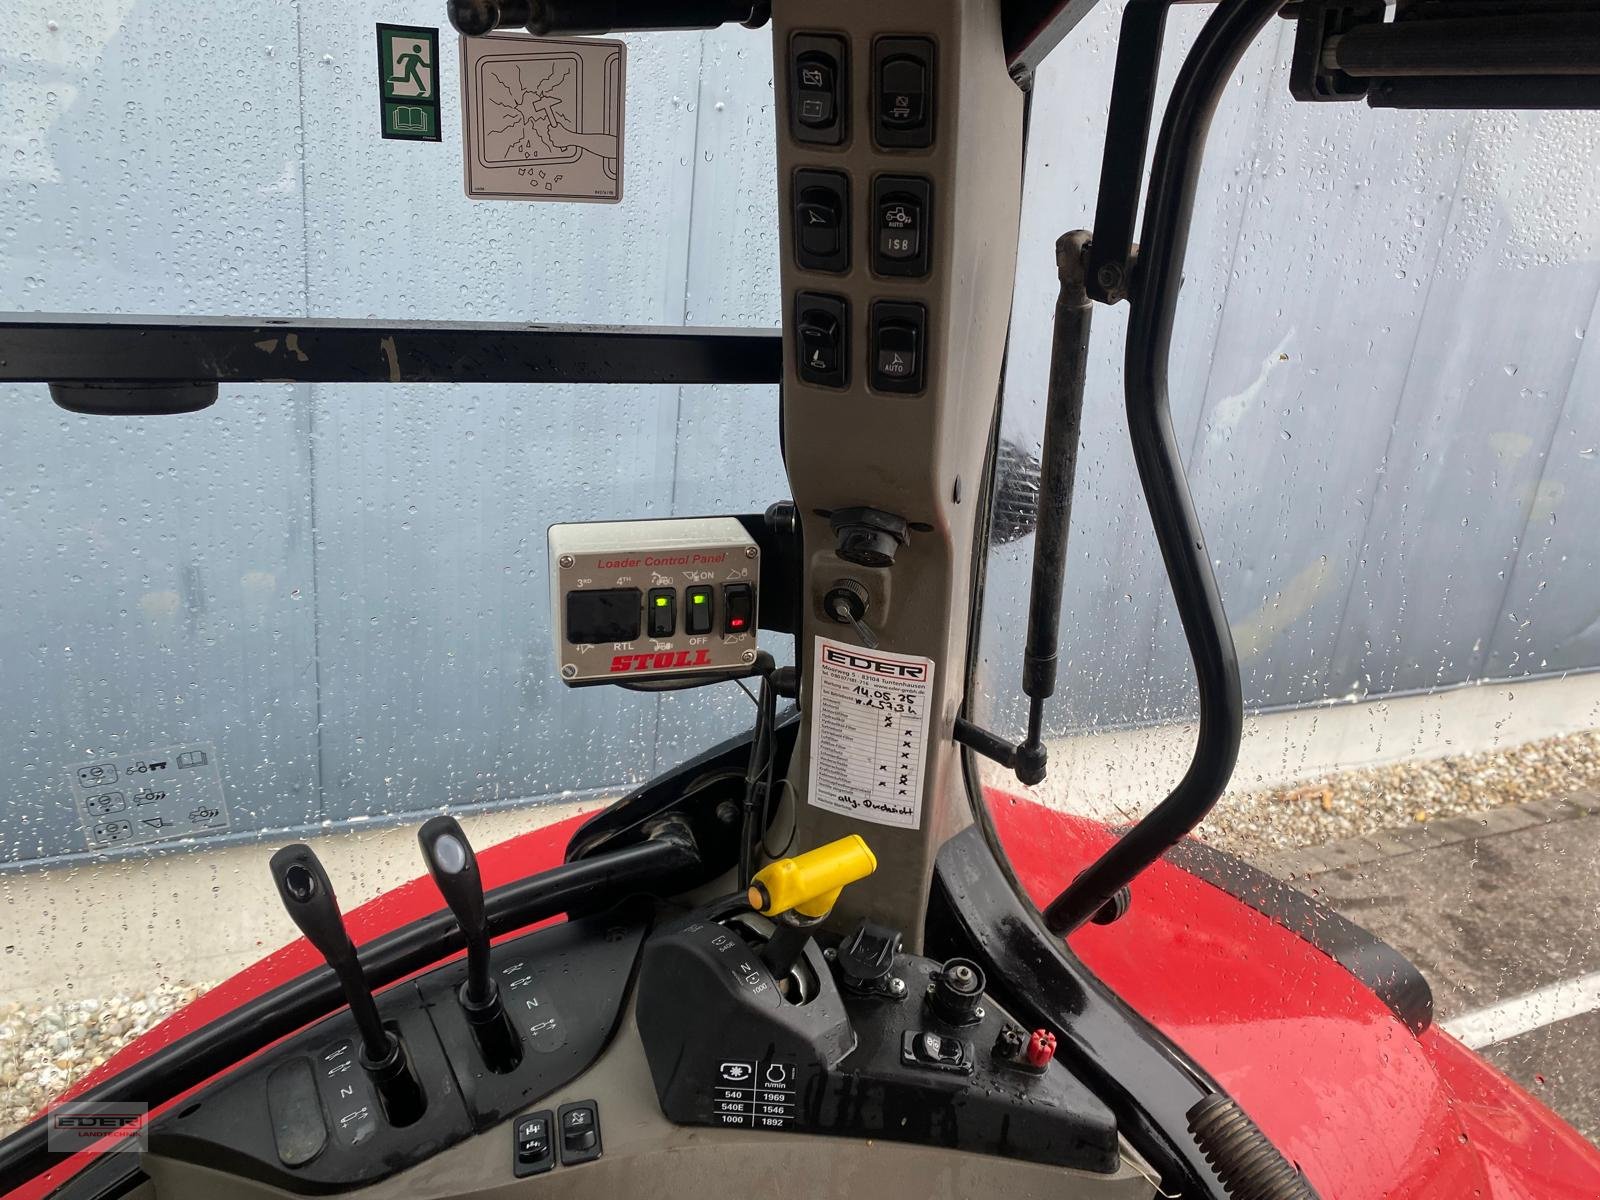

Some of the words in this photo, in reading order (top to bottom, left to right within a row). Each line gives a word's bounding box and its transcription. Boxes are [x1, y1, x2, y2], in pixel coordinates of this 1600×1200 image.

[597, 559, 641, 569] Loader
[644, 555, 688, 567] Control
[692, 553, 726, 564] Panel
[700, 571, 714, 580] ON
[616, 576, 632, 586] 4TH
[689, 637, 708, 646] OFF
[614, 642, 634, 651] RTL
[610, 650, 711, 673] STOLL
[826, 650, 923, 679] EDER
[861, 674, 880, 683] 83104
[882, 679, 926, 690] Tuntenhausen
[852, 685, 917, 705] 14.05.25
[752, 982, 768, 994] 1000
[725, 1091, 742, 1099] 540
[763, 1093, 785, 1102] 1969
[721, 1103, 744, 1111] 540E
[762, 1106, 784, 1114] 1546
[721, 1115, 744, 1123] 1000
[761, 1118, 784, 1127] 1892
